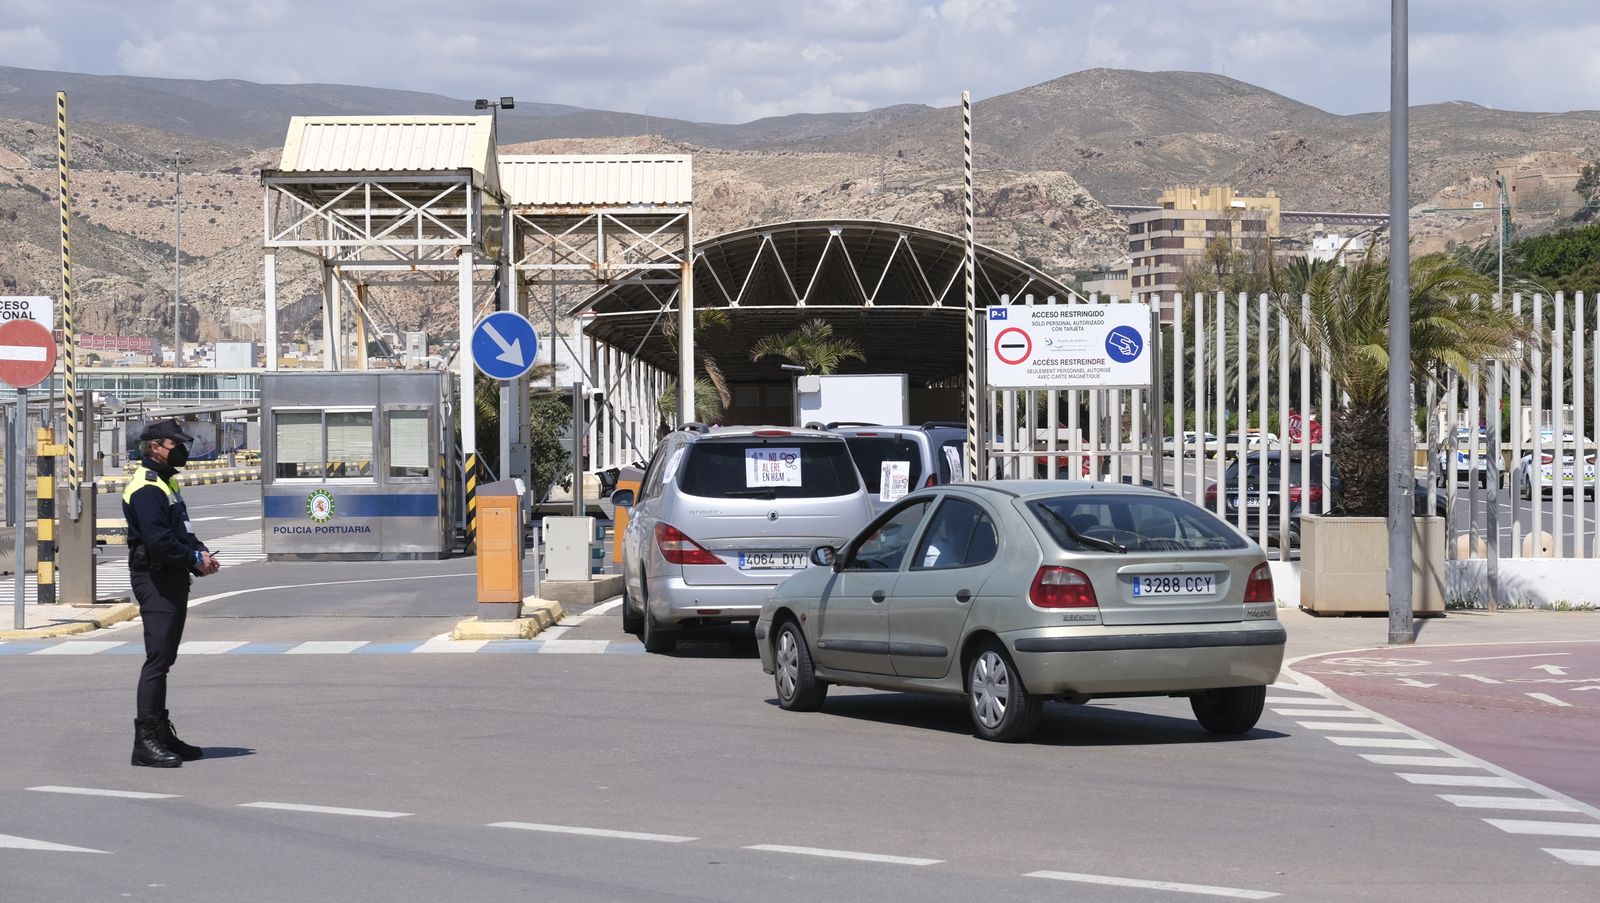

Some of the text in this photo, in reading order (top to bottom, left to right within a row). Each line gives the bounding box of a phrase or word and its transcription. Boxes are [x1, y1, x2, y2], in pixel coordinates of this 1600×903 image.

[769, 452, 776, 461] NO
[762, 463, 780, 472] AL ERE
[763, 473, 770, 481] EN
[747, 554, 804, 565] 4064 DVY
[1144, 577, 1211, 593] 3288 CCY
